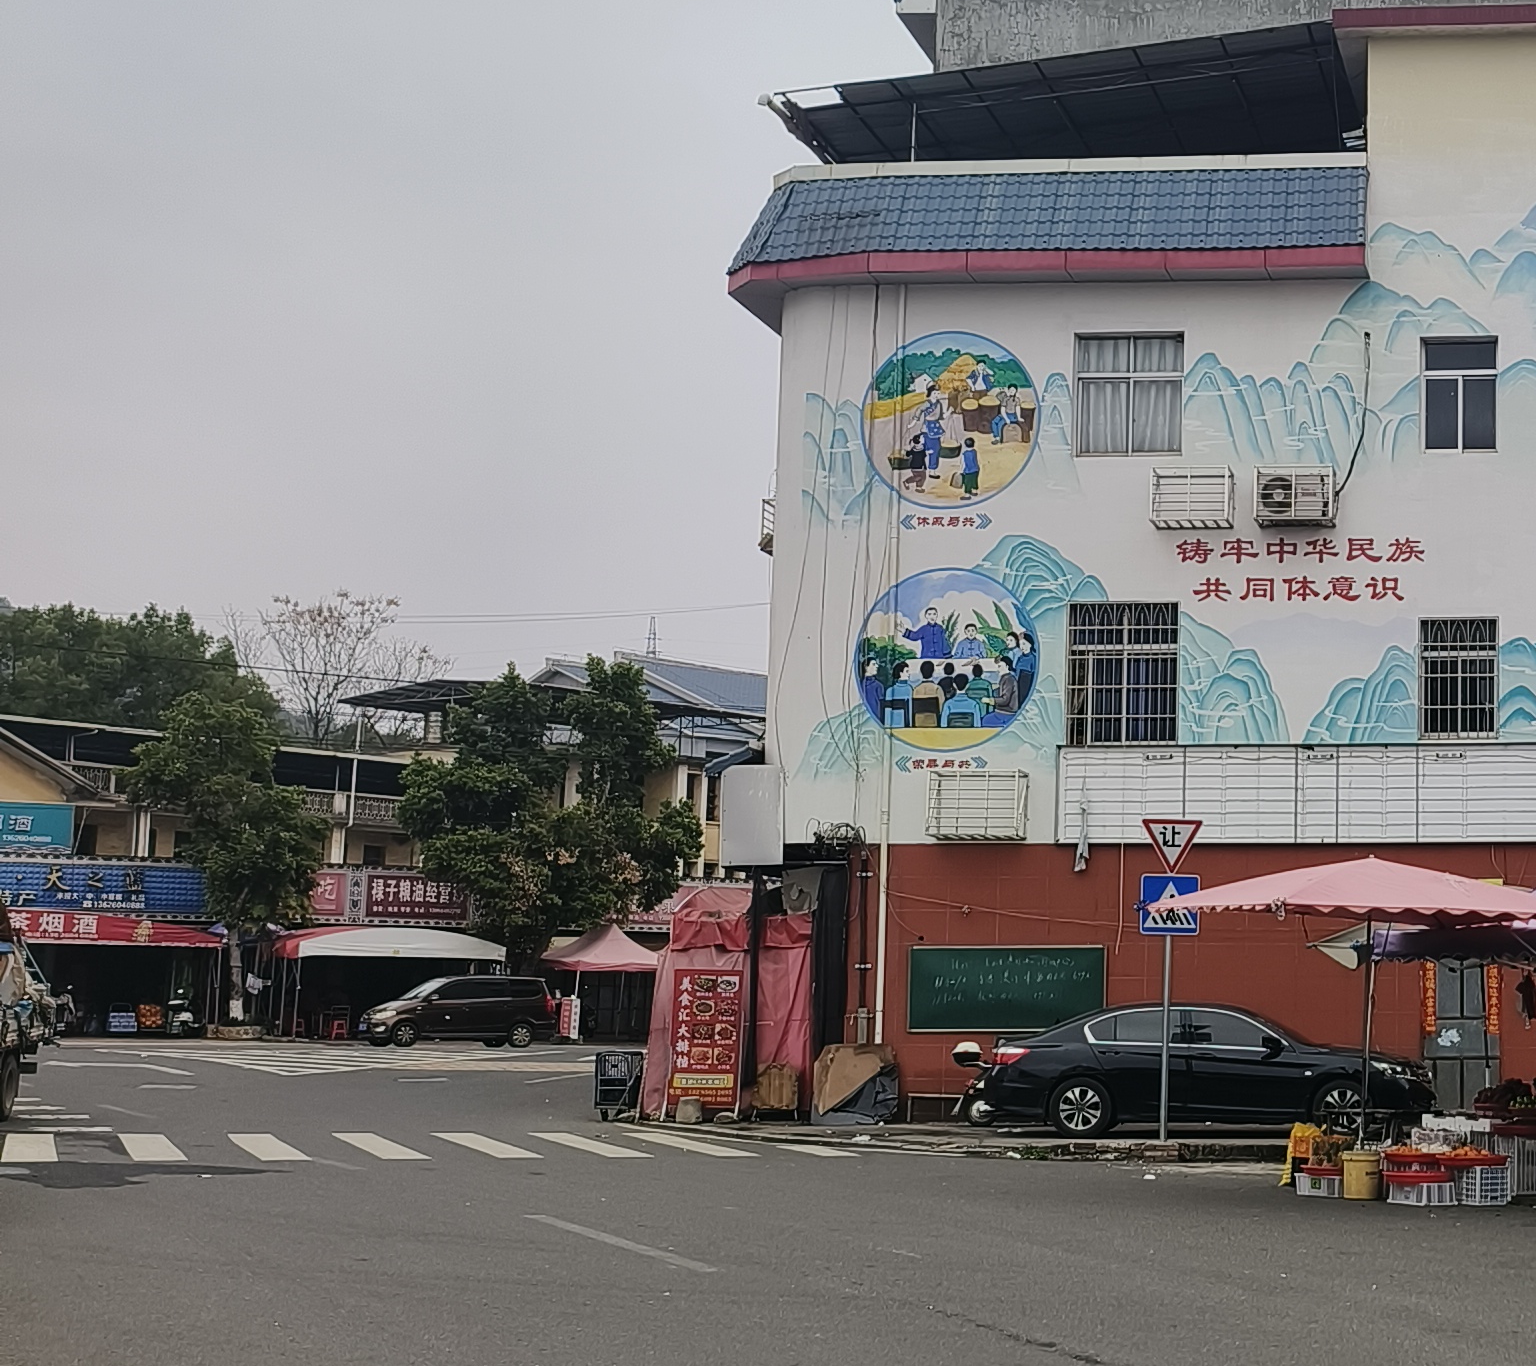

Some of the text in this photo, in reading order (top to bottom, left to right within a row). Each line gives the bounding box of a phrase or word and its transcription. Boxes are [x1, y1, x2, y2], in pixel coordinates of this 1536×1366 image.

[916, 516, 976, 527] 休戚与共
[1176, 537, 1425, 564] 铸牢中华民族
[1192, 575, 1405, 602] 共同体意识
[1159, 825, 1182, 848] 让
[7, 911, 99, 933] 茶烟酒
